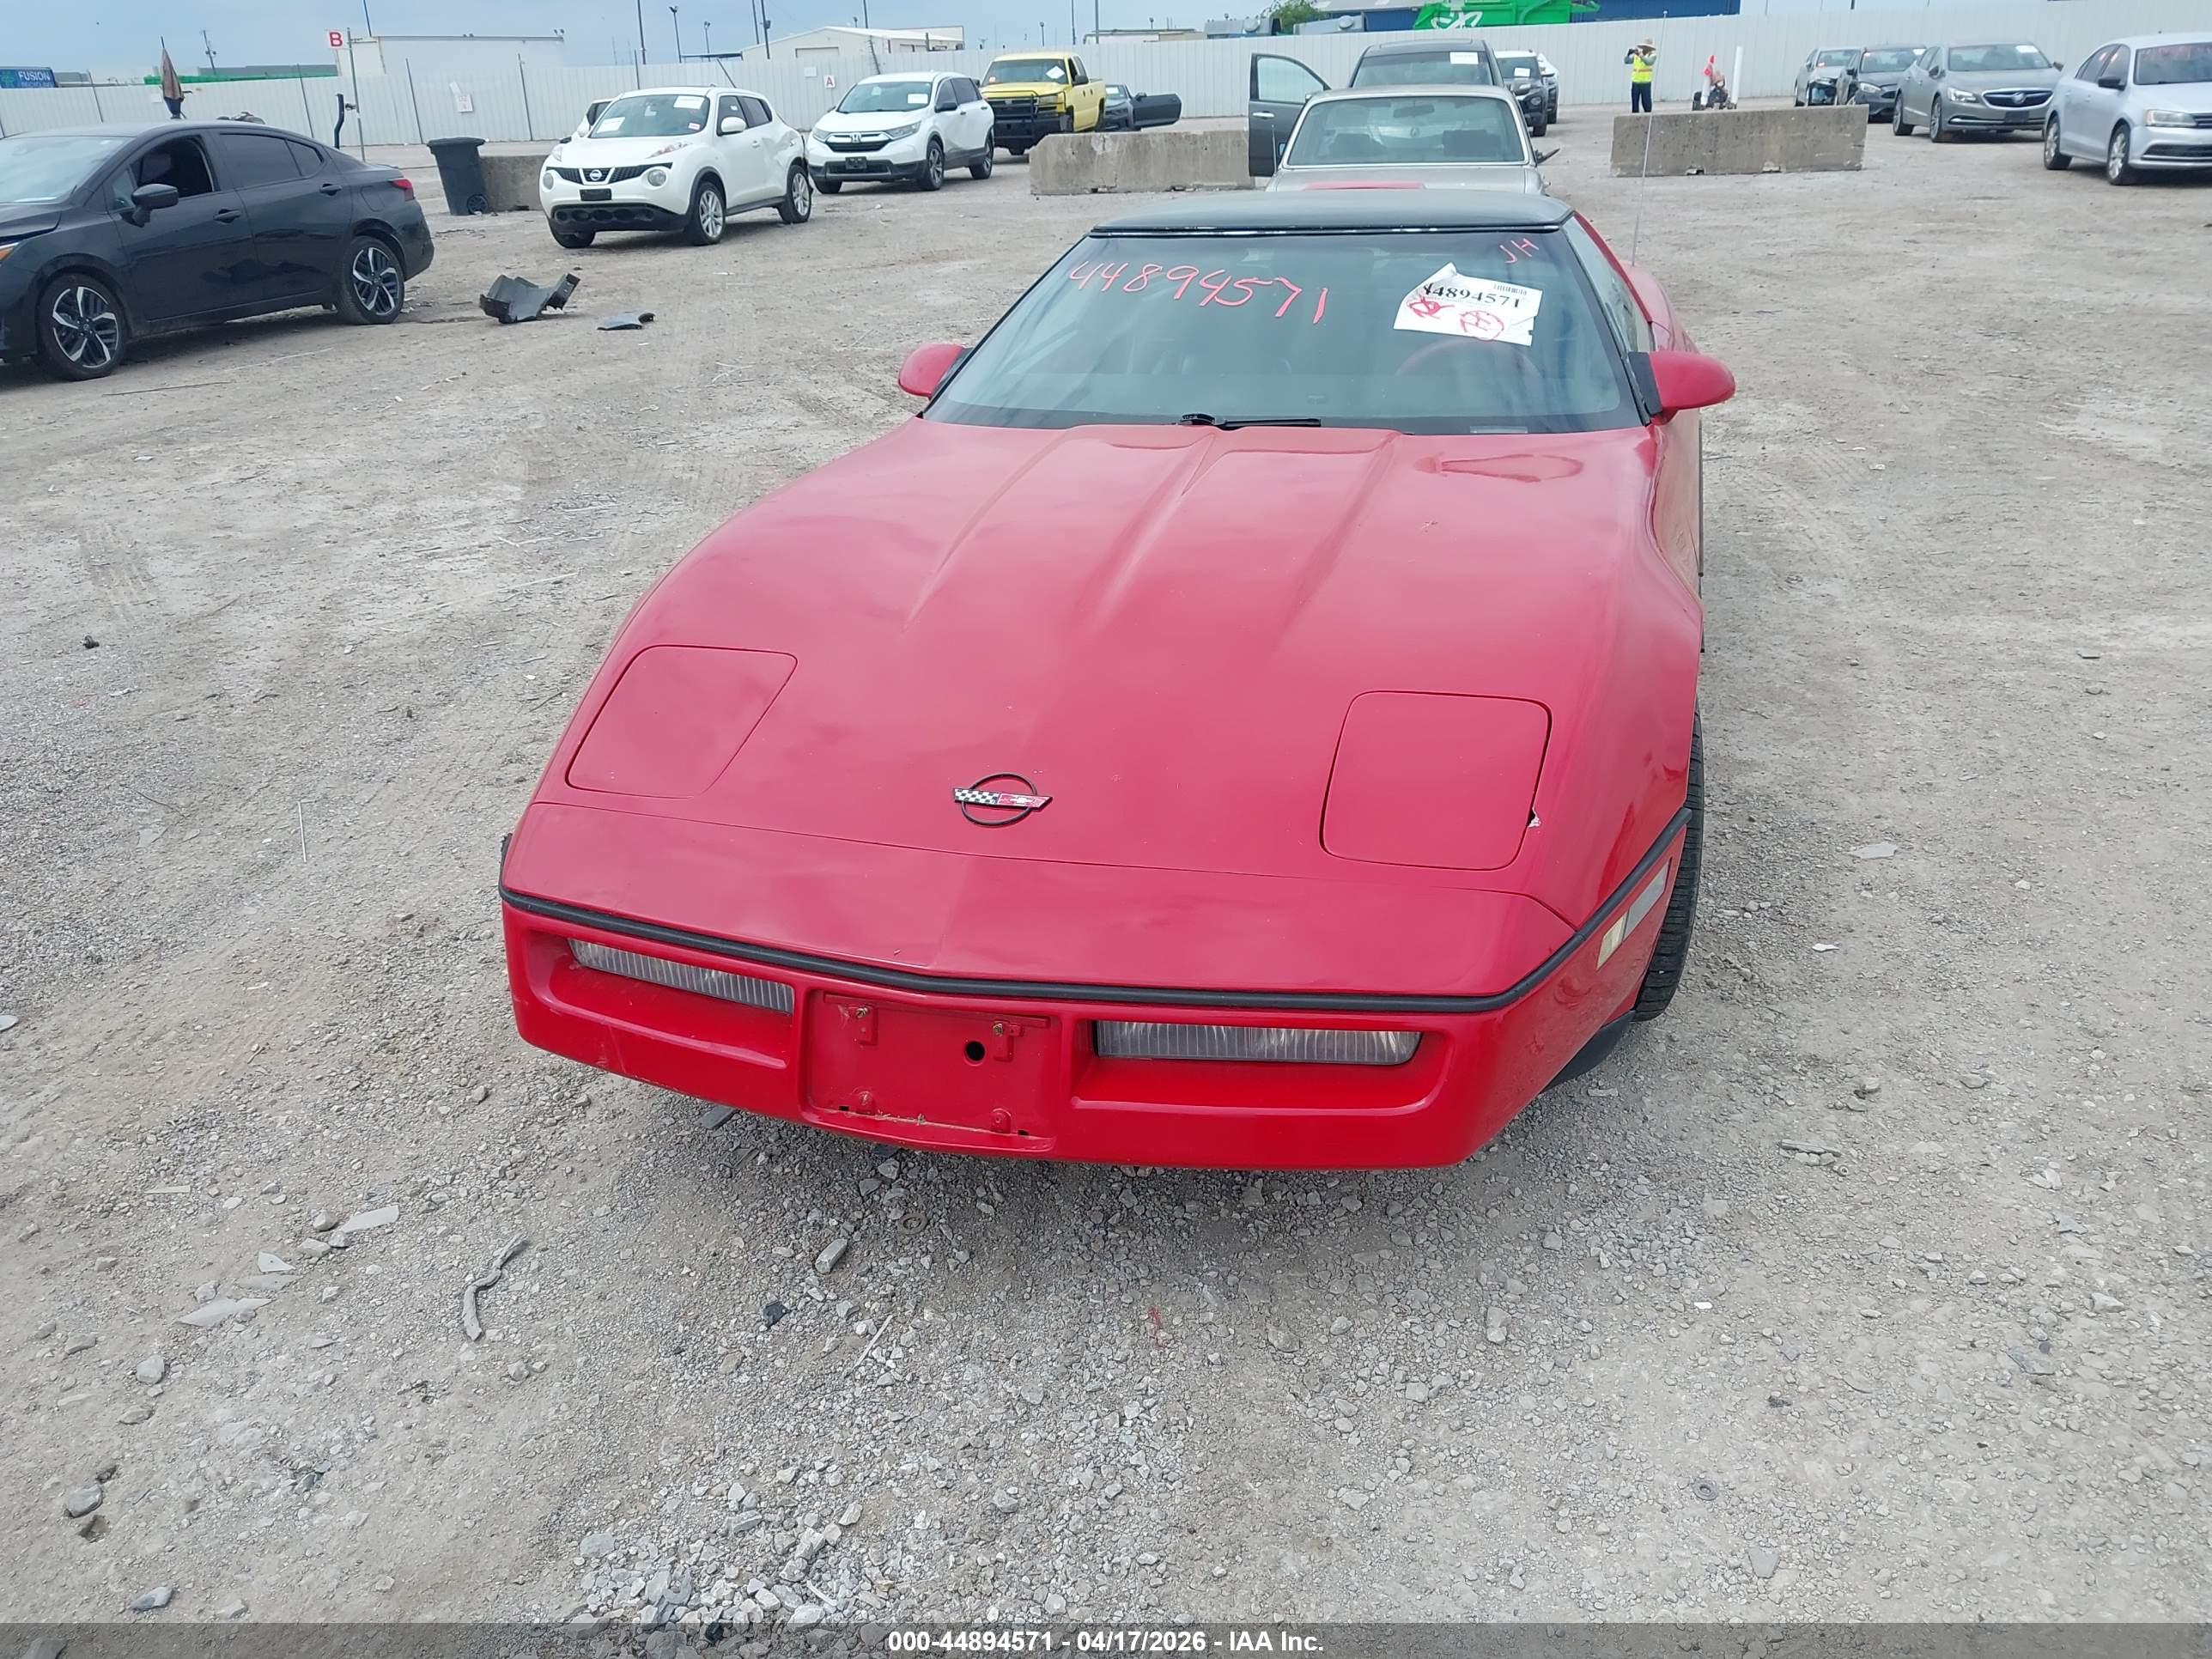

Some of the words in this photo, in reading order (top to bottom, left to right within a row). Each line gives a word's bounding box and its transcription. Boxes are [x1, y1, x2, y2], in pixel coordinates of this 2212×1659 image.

[329, 31, 343, 47] B
[17, 70, 51, 82] FUSION
[826, 76, 834, 87] A
[1499, 238, 1540, 264] JH
[1068, 260, 1328, 325] 44894571
